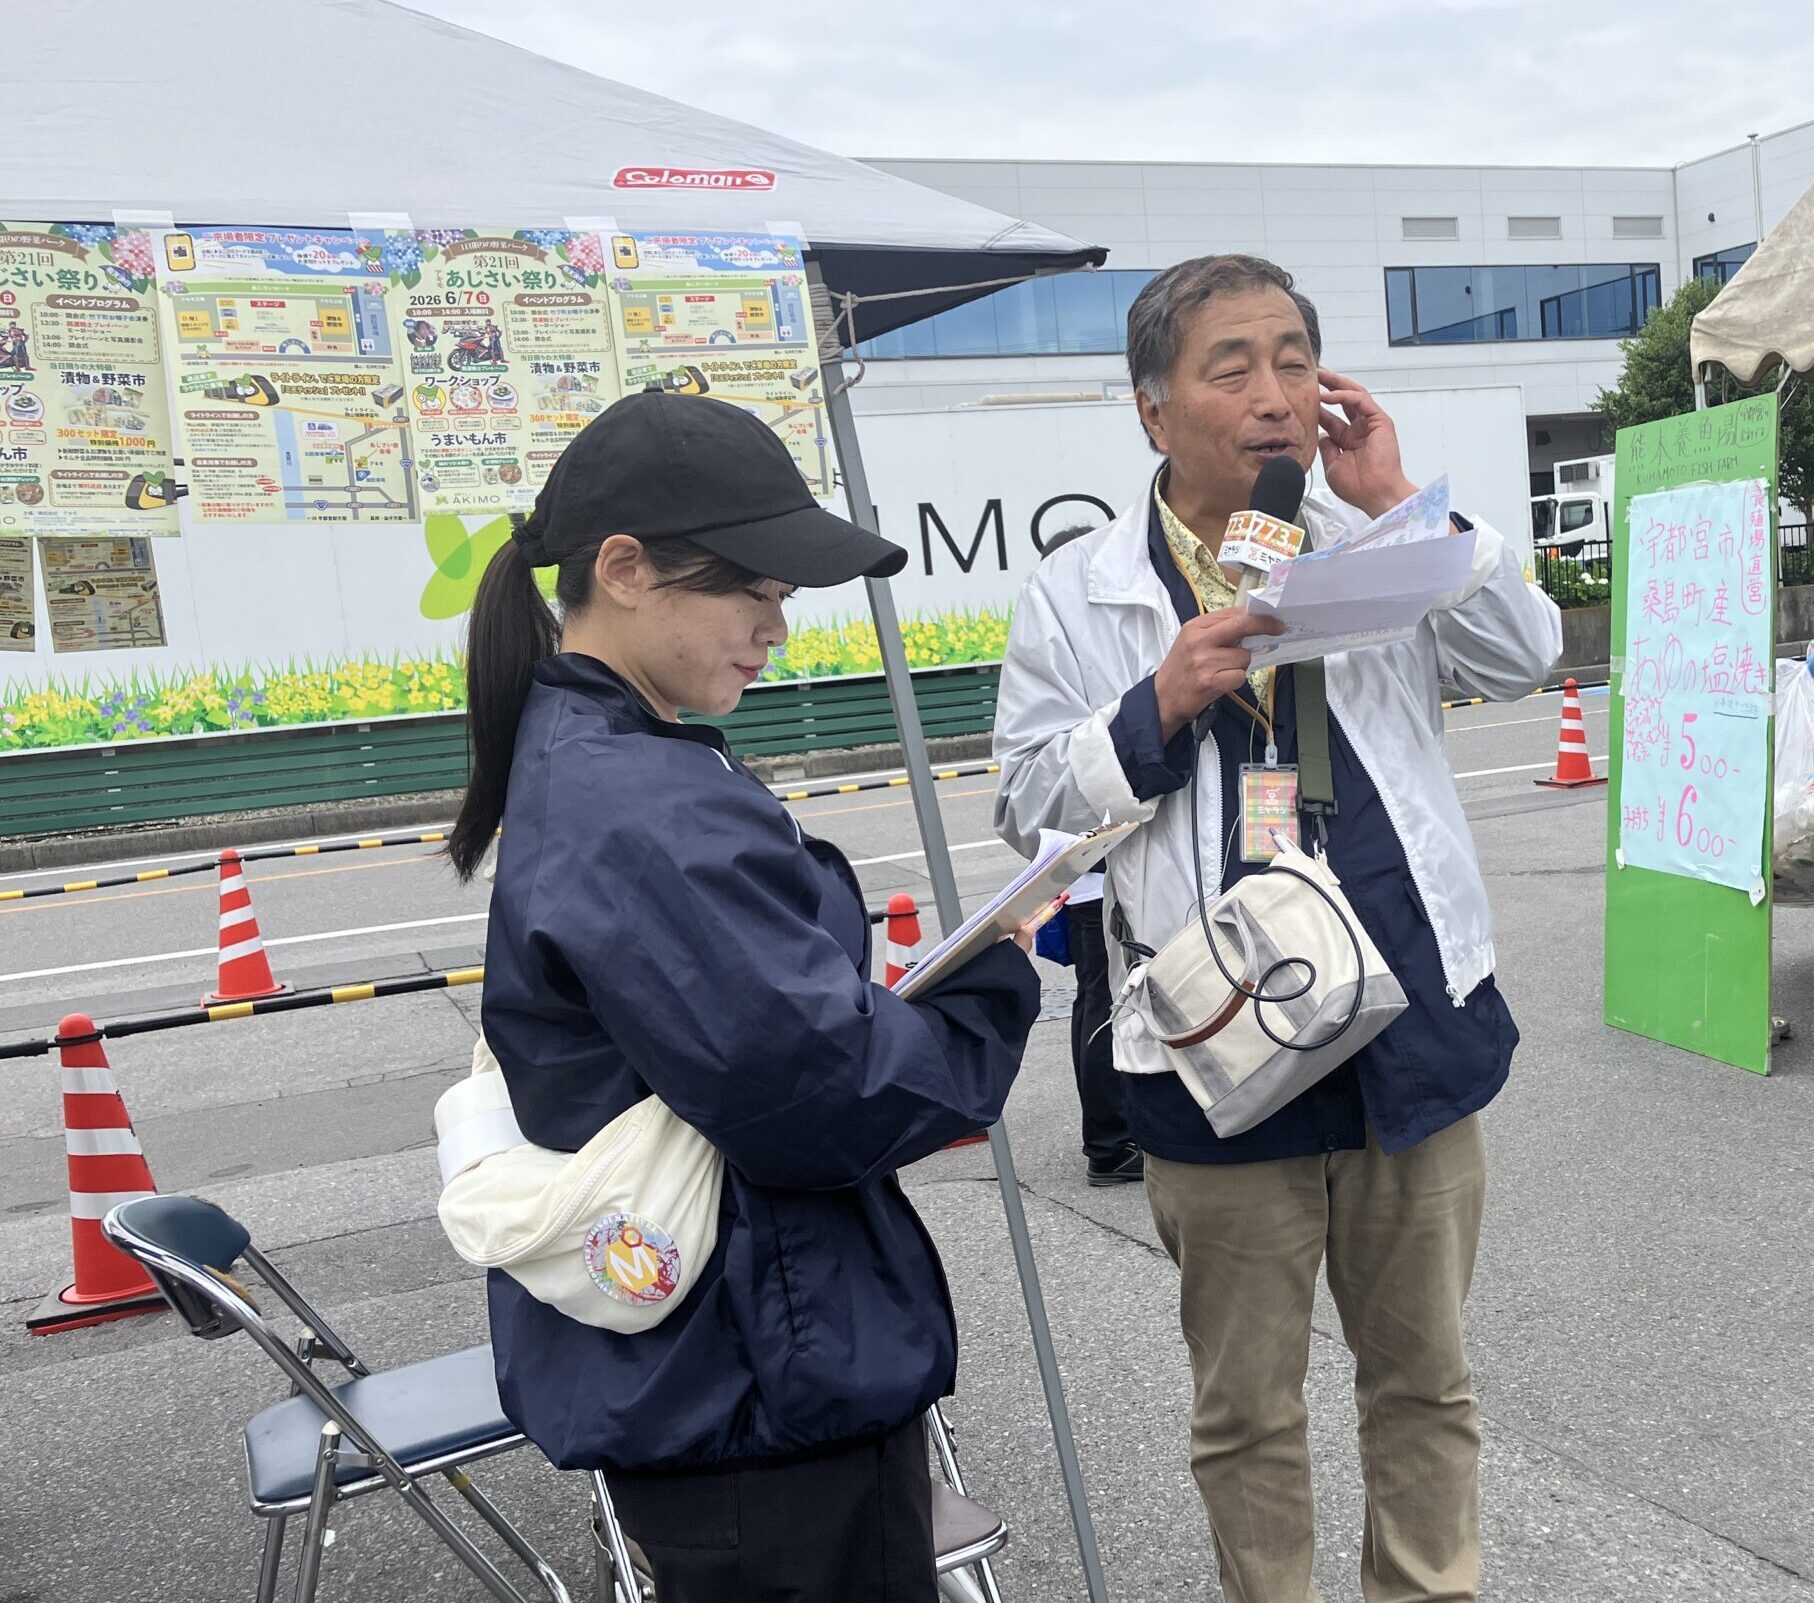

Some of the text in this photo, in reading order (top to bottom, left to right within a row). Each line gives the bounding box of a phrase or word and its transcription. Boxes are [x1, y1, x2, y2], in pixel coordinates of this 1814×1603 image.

[625, 170, 742, 186] Coleman
[473, 255, 520, 269] 第21回
[446, 269, 557, 289] あじさい祭り
[55, 299, 130, 309] イベントプログラム
[410, 295, 441, 306] 2026
[445, 291, 473, 306] 6/7
[523, 296, 584, 304] イベントプログラム
[425, 375, 500, 387] ワークショップ
[431, 432, 507, 446] うまいもん市
[453, 495, 501, 504] AKIMO
[1251, 519, 1291, 547] 77.3
[1640, 513, 1736, 569] 宇都宮市
[1642, 578, 1733, 626] 桑島町産
[1631, 632, 1767, 699] あゆの塩焼き
